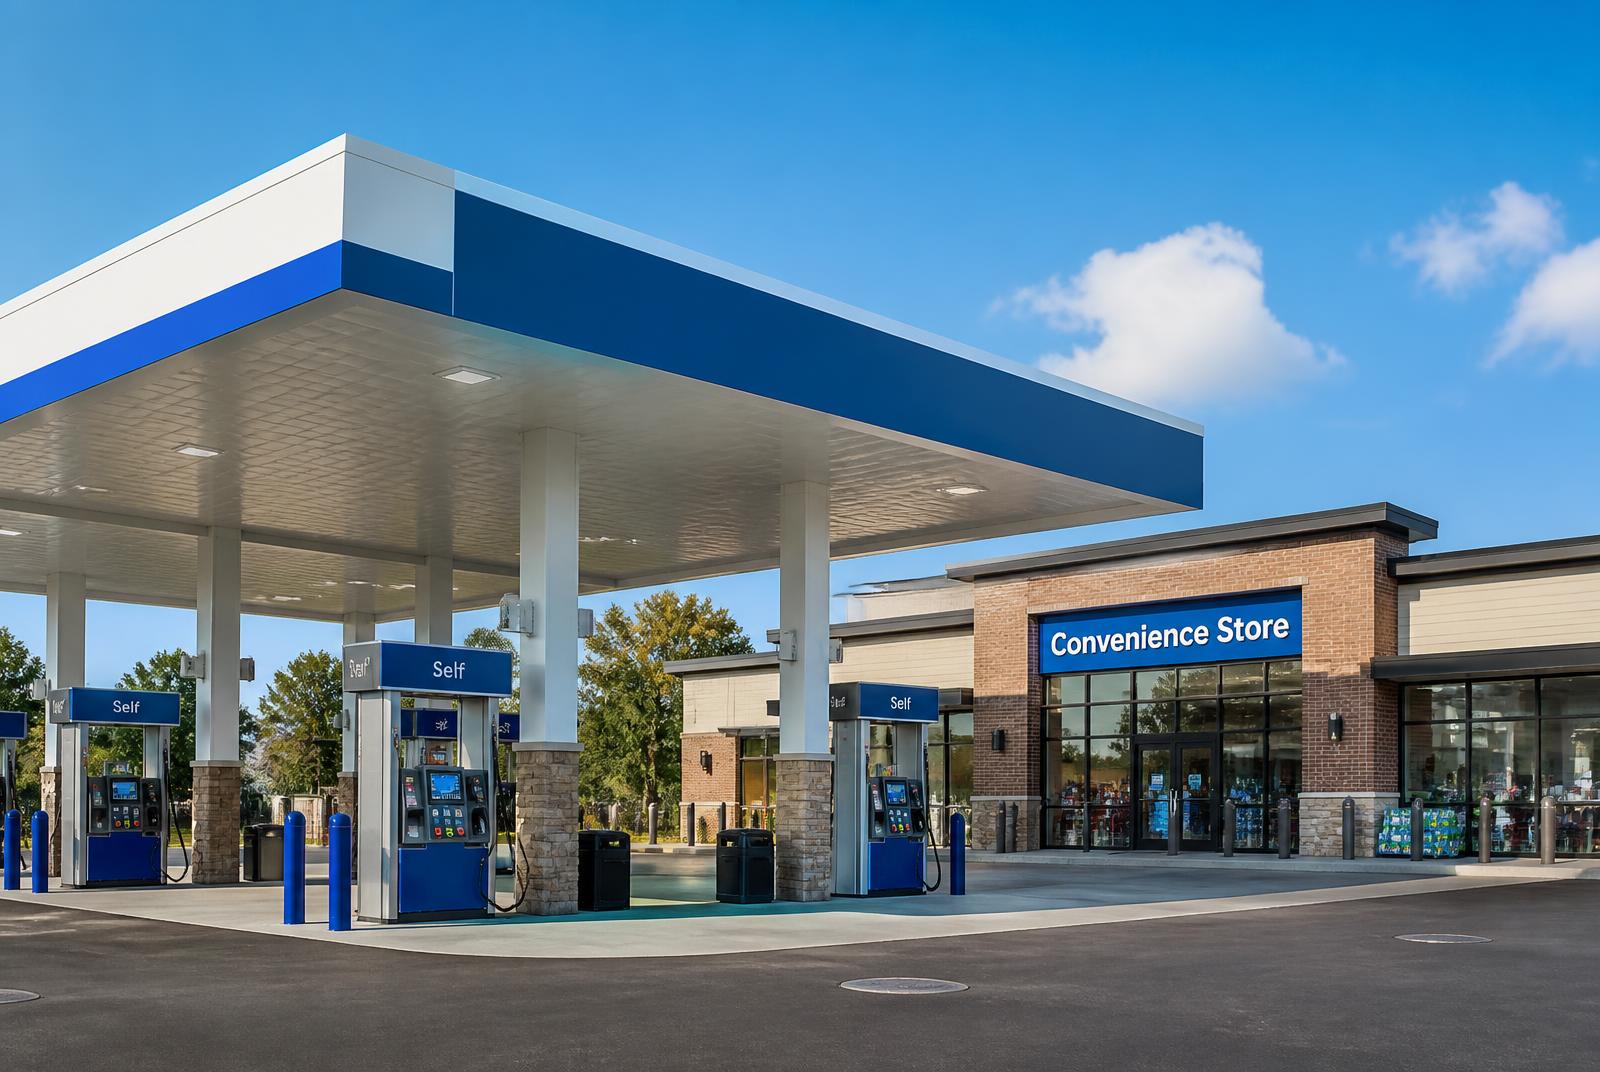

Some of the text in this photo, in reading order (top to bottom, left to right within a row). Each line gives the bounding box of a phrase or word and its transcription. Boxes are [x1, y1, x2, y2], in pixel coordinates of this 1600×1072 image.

[1051, 616, 1290, 656] Convenience Store
[433, 661, 465, 679] Self
[113, 700, 140, 714] Self
[890, 696, 911, 710] Self
